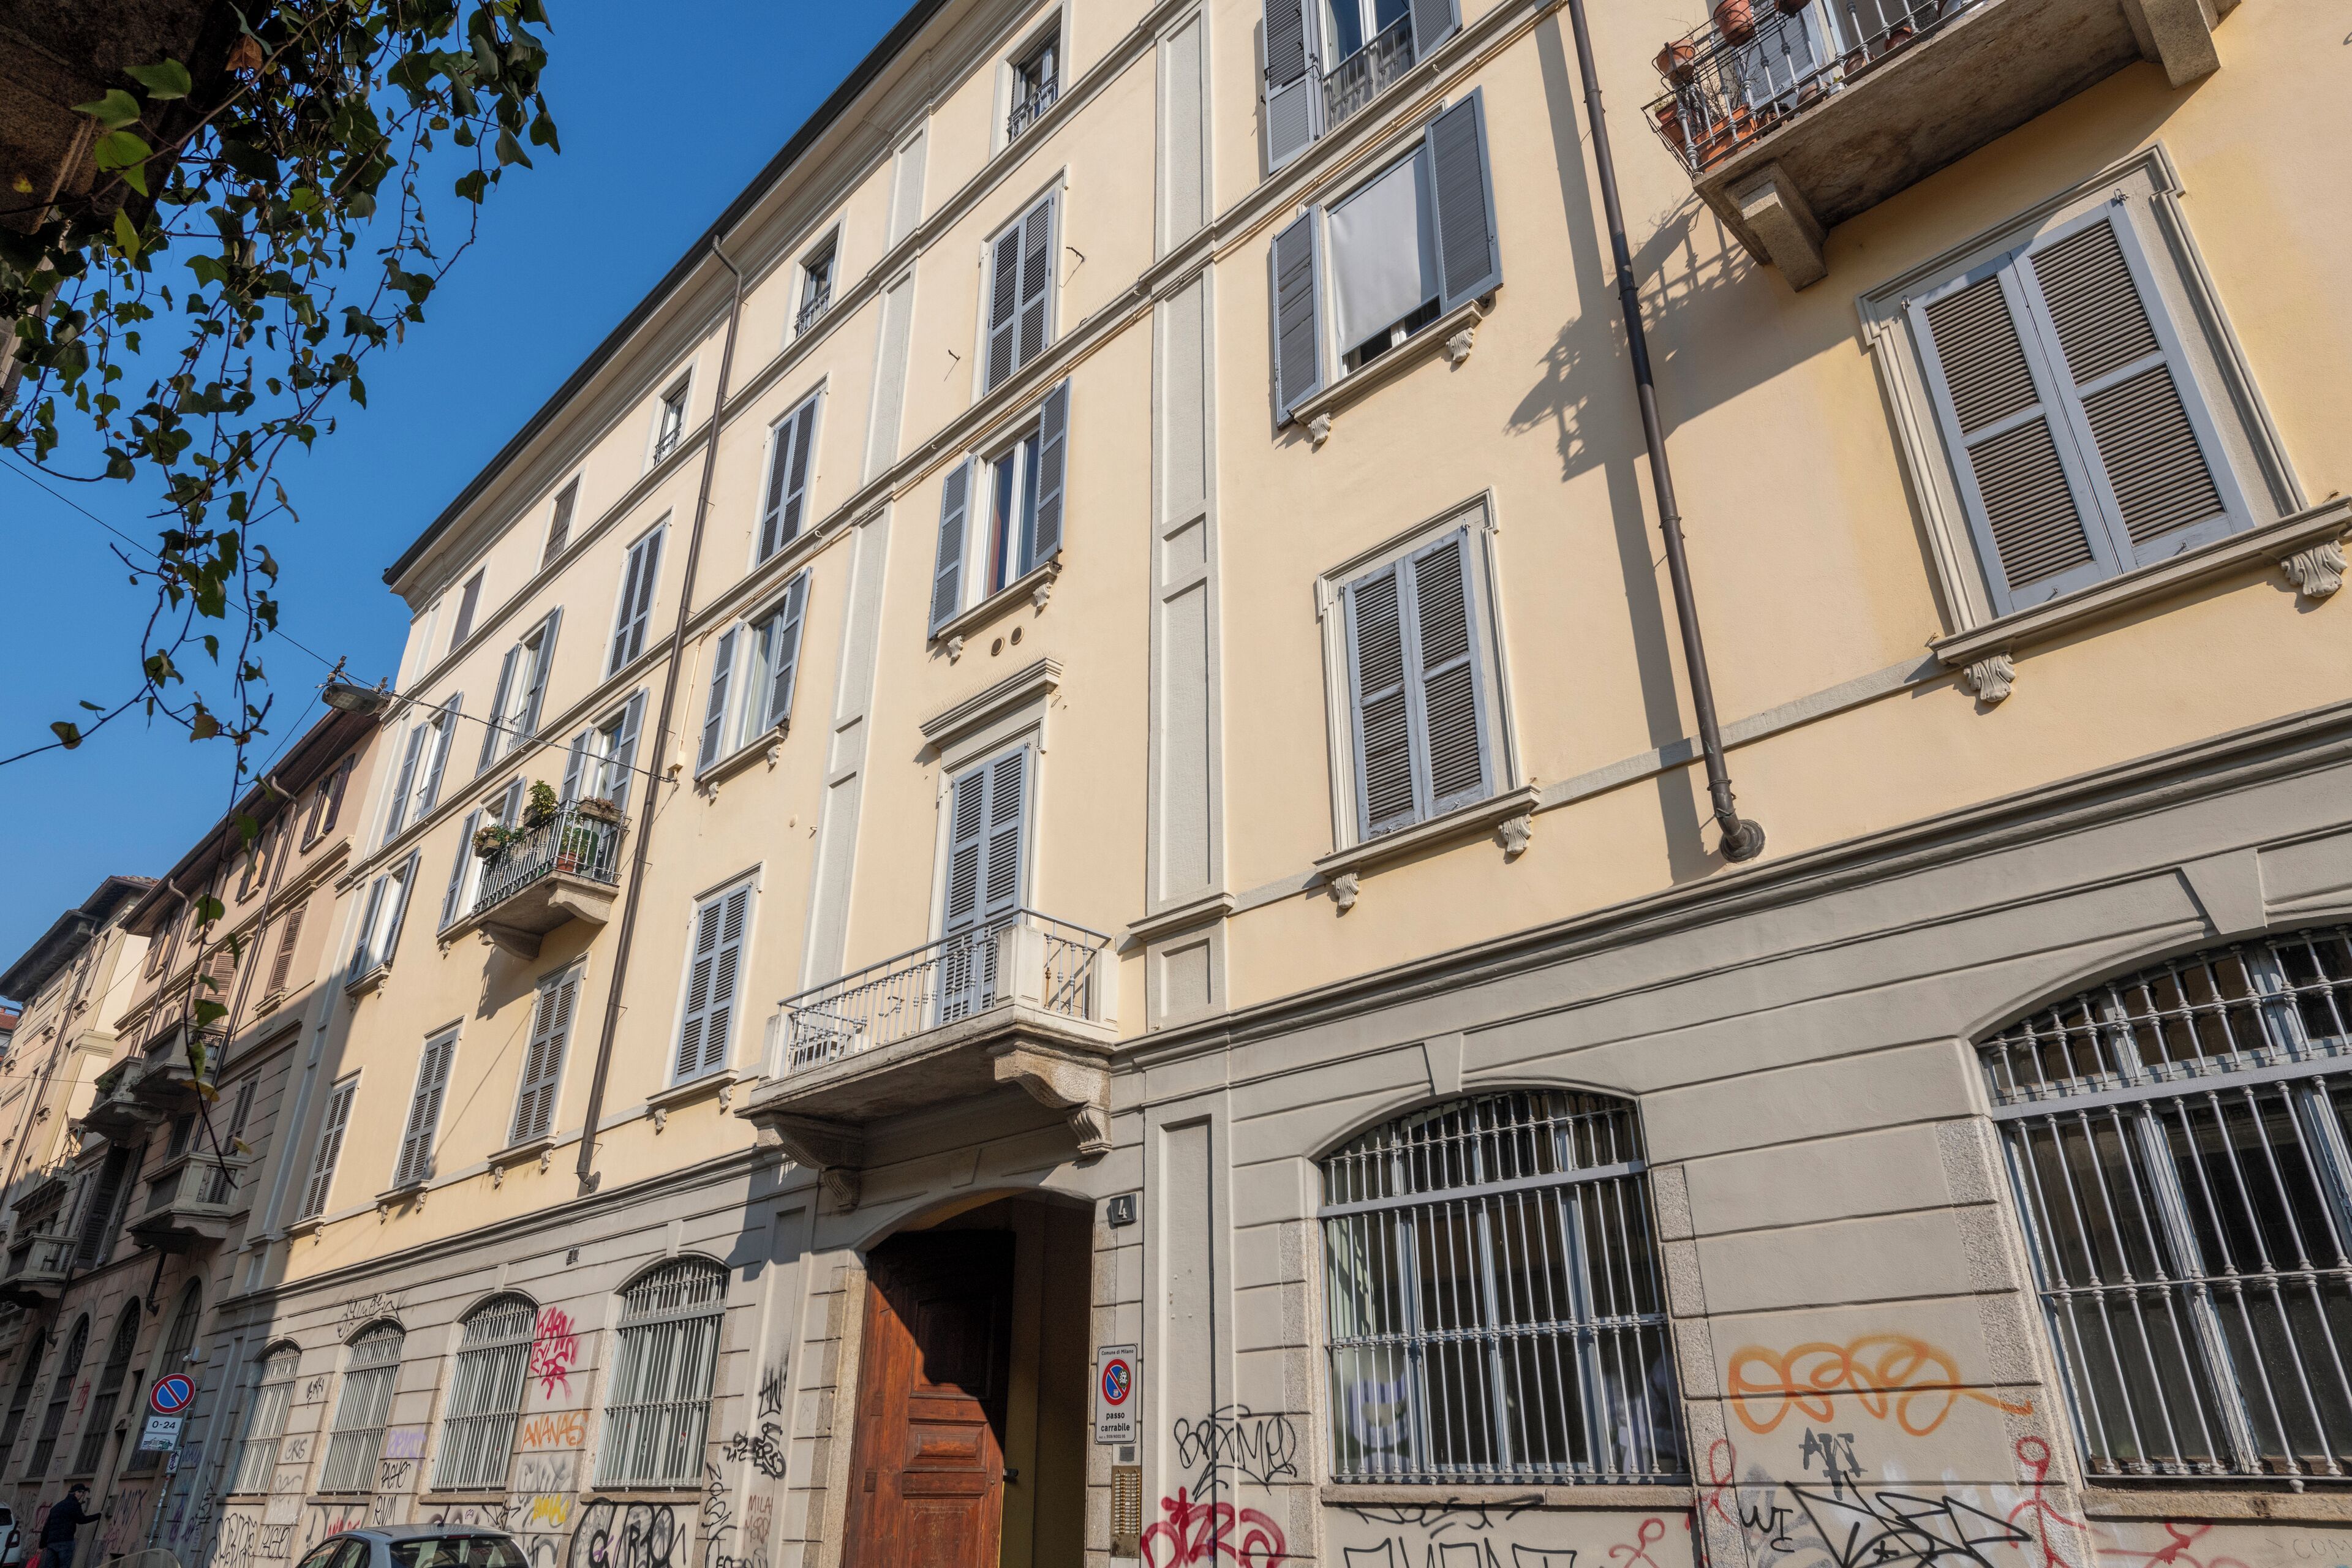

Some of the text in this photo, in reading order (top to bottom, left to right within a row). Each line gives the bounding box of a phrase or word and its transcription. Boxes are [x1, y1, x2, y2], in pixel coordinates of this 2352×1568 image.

[1118, 1199, 1128, 1219] 4
[152, 1420, 176, 1430] 0-24
[1101, 1423, 1130, 1431] carrabile
